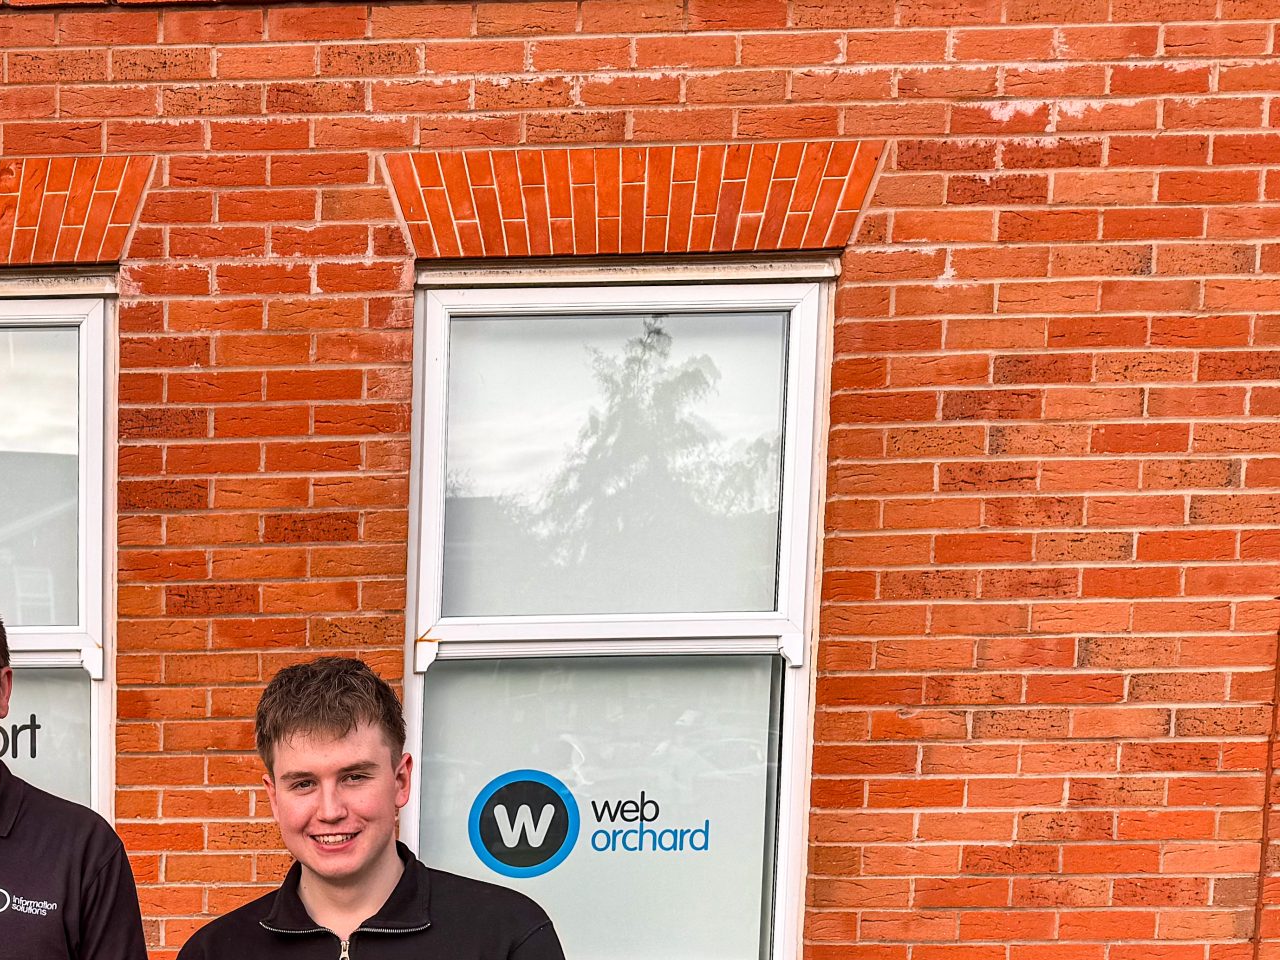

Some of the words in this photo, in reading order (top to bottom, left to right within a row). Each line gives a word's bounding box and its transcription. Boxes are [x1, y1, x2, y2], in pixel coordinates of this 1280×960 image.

[591, 790, 660, 823] web
[590, 819, 710, 851] orchard
[11, 903, 47, 916] solutions
[12, 895, 58, 910] information
